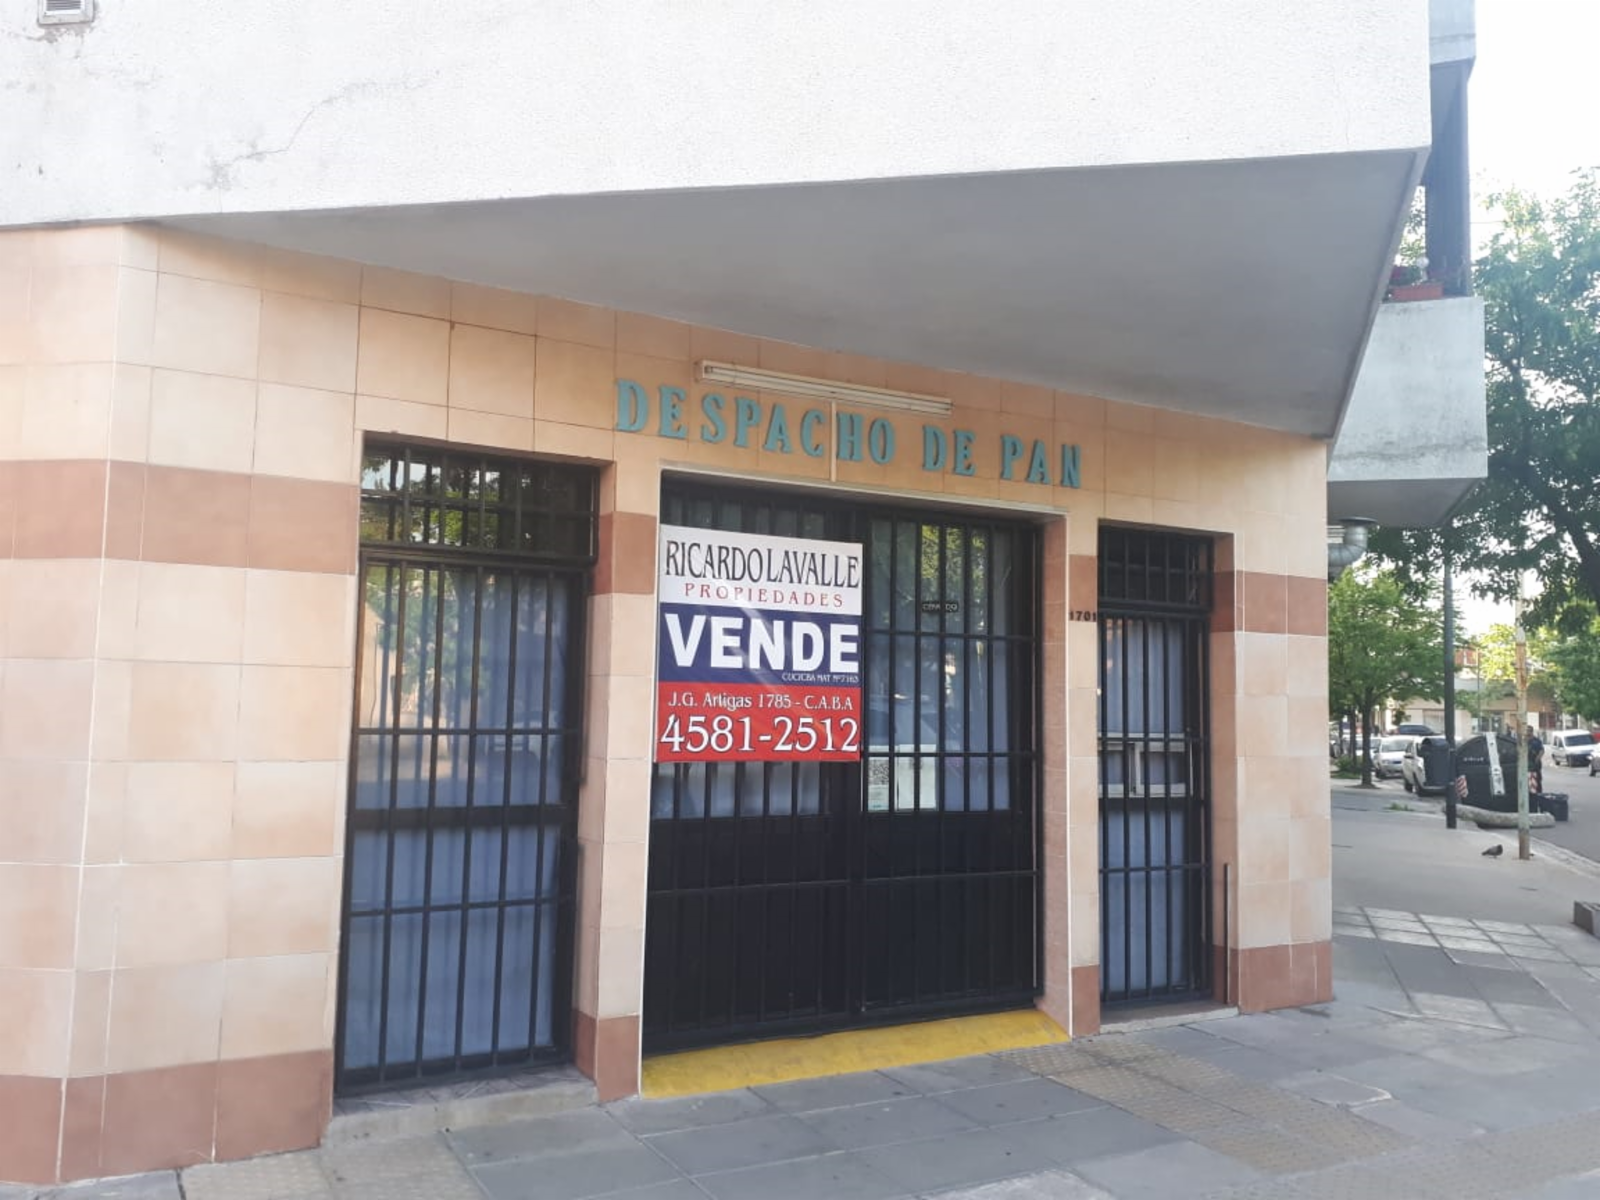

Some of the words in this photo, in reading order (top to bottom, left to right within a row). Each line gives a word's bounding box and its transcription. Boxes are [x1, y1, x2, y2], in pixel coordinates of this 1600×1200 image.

[615, 379, 895, 465] DESPACHO
[922, 424, 976, 476] DE
[1000, 433, 1081, 489] PAN
[685, 582, 844, 608] PROPIEDADES
[1069, 610, 1097, 622] 1701
[664, 612, 860, 674] VENDE
[668, 691, 698, 707] J.G.
[702, 692, 752, 712] Artigas
[758, 693, 792, 709] 1785
[804, 695, 854, 711] C.A.B.A
[660, 713, 859, 753] 4581-2512
